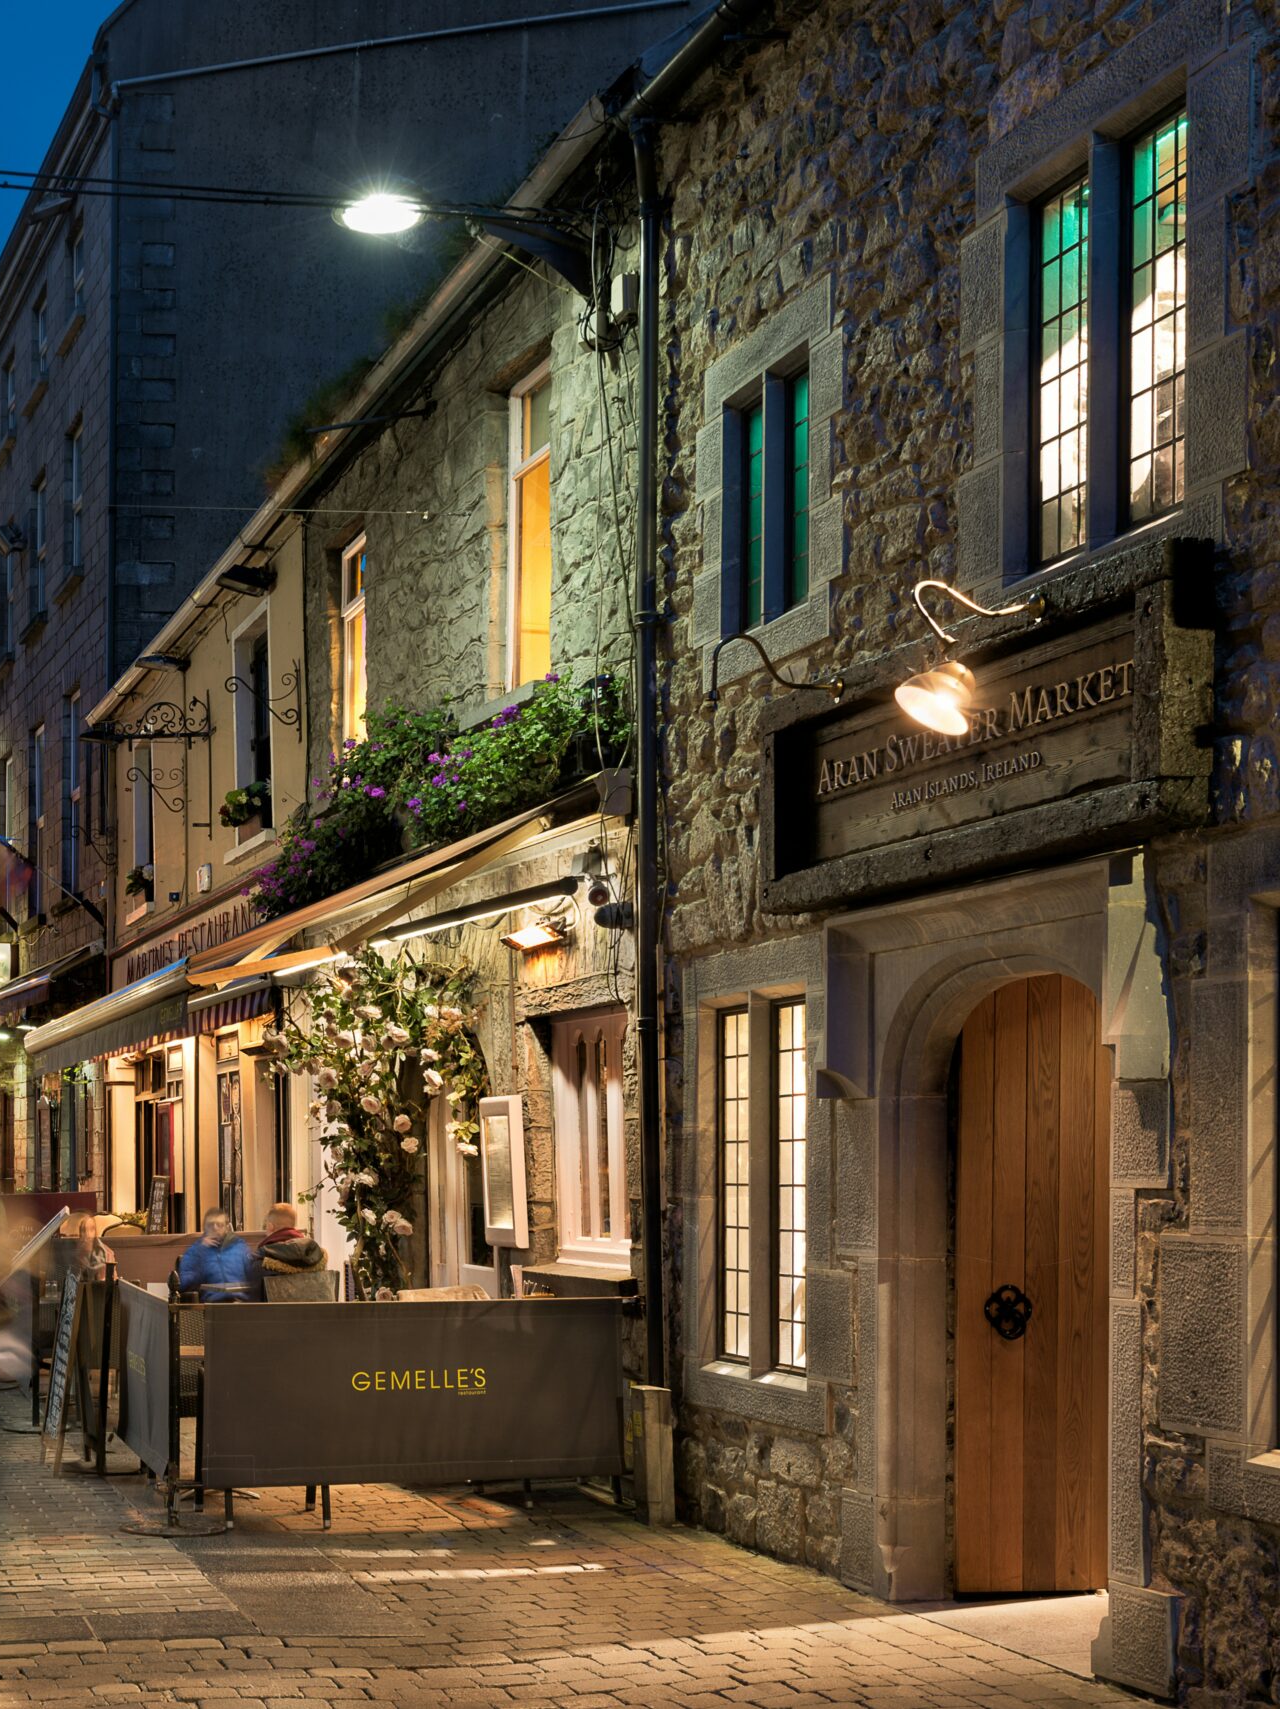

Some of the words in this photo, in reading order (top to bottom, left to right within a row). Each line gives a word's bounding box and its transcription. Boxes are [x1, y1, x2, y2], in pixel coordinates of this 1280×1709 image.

[817, 748, 878, 795] ARAN
[1008, 660, 1135, 732] MARKET
[890, 787, 922, 810] ARAN
[924, 771, 979, 800] ISLANDS,
[982, 751, 1041, 783] IRELAND
[351, 1368, 487, 1391] GEMELLE'S
